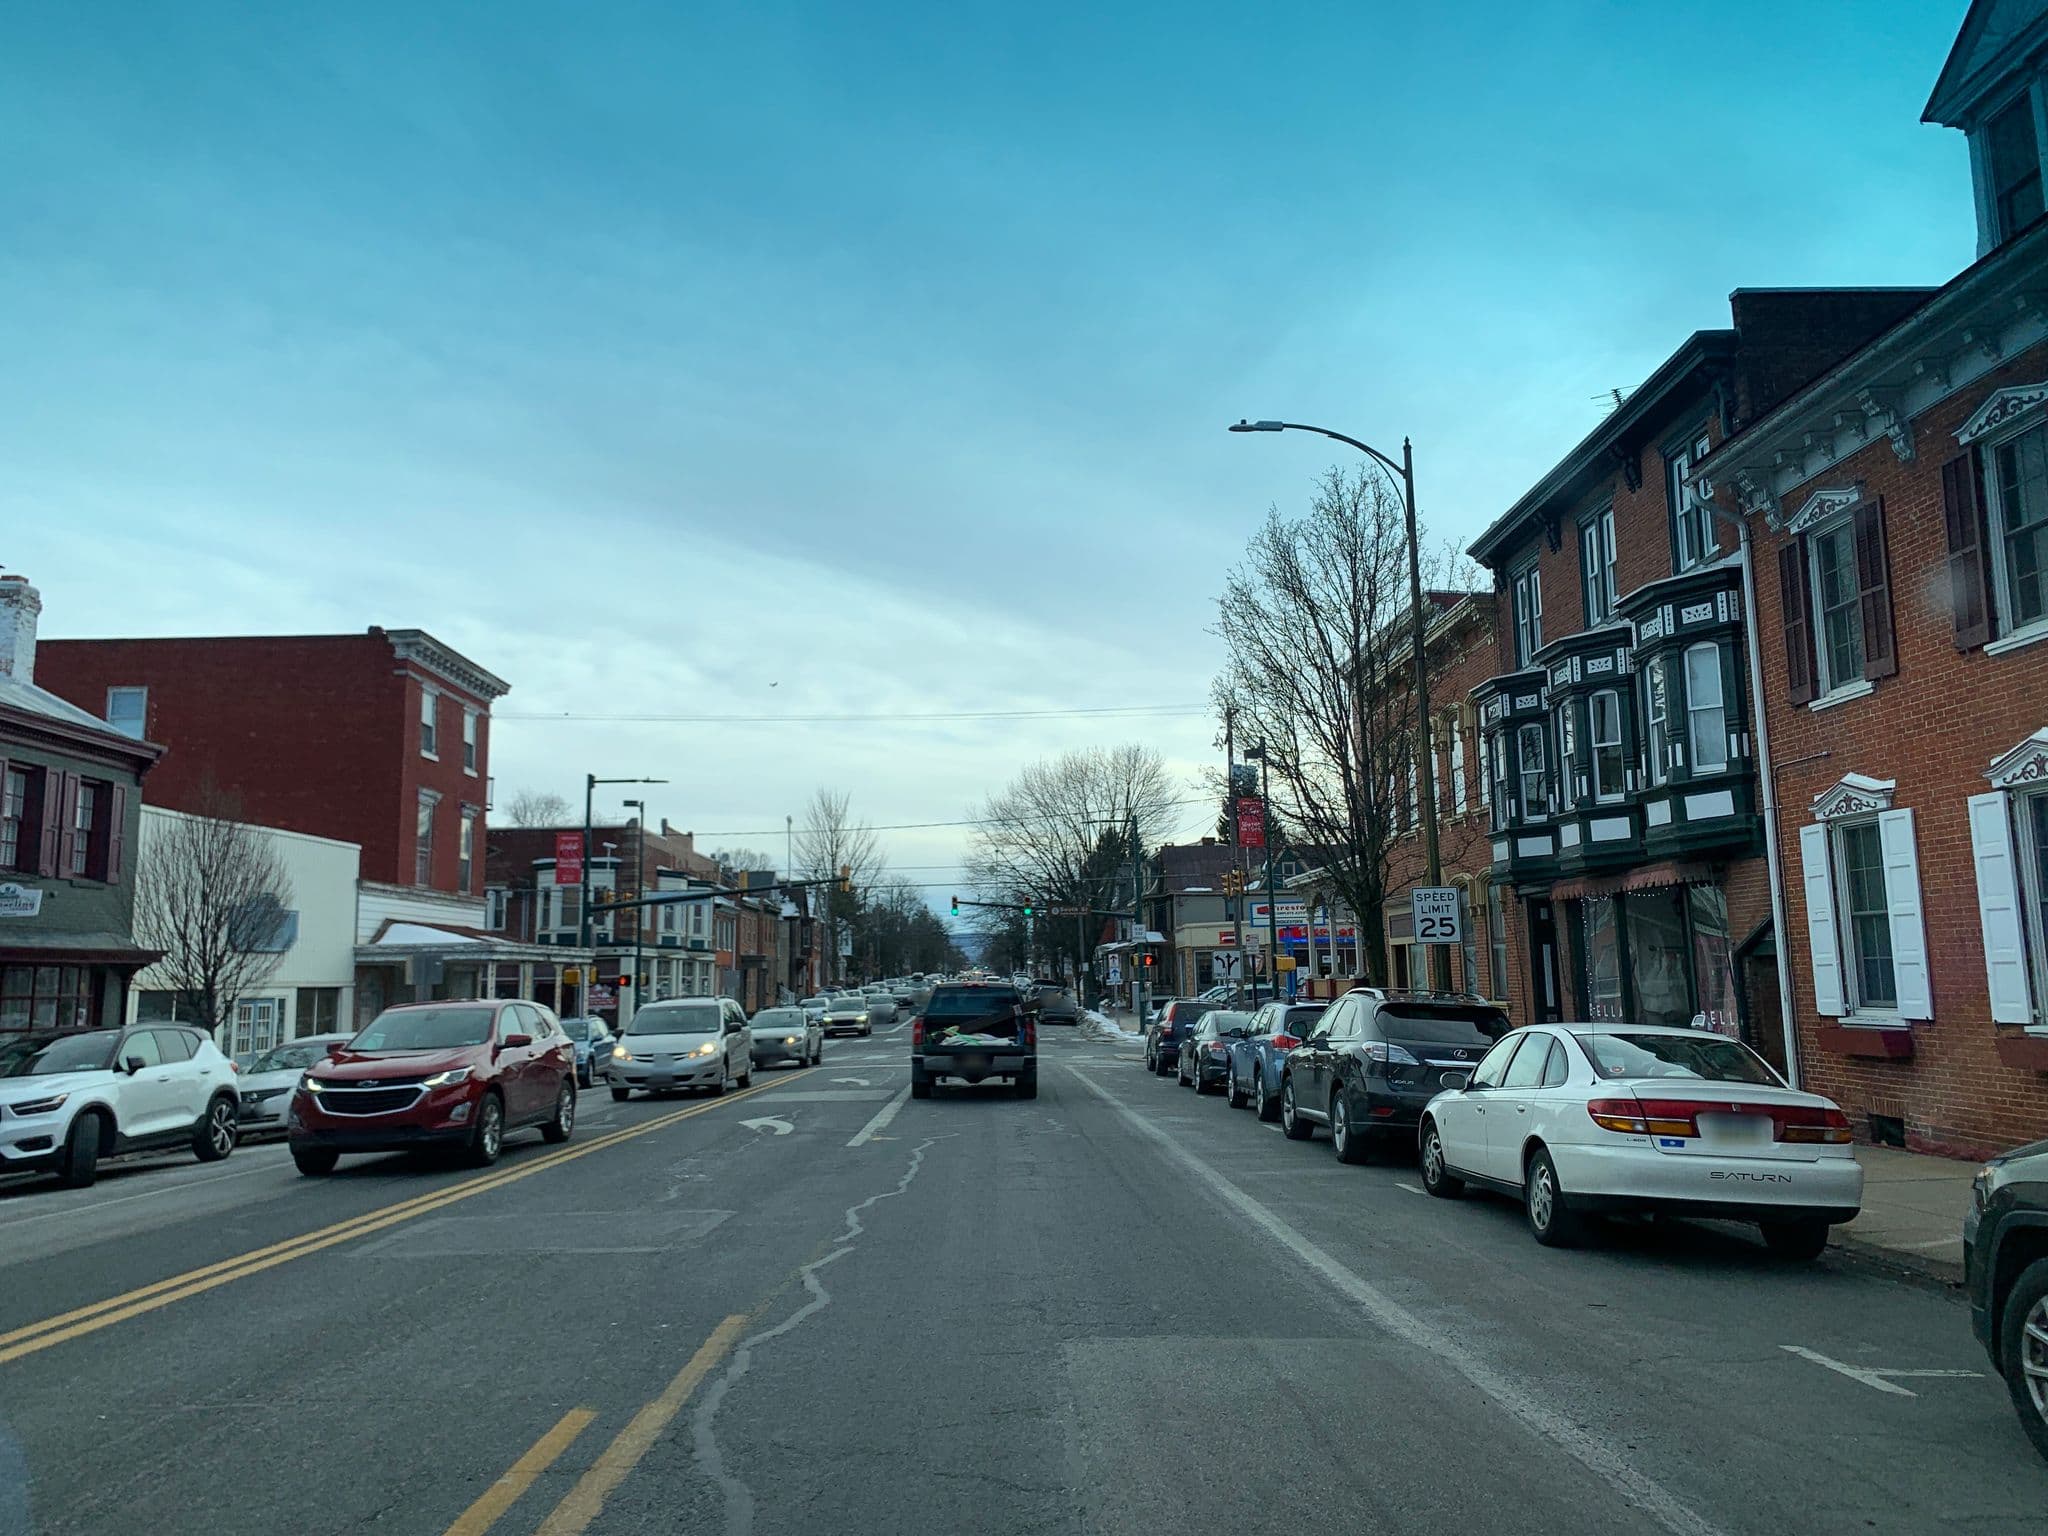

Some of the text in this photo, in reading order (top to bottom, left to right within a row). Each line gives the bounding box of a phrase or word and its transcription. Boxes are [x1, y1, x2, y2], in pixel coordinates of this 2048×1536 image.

[1416, 892, 1455, 902] SPEED
[1420, 904, 1451, 914] LIMIT
[1420, 916, 1456, 938] 25
[1710, 1171, 1792, 1183] SATURN
